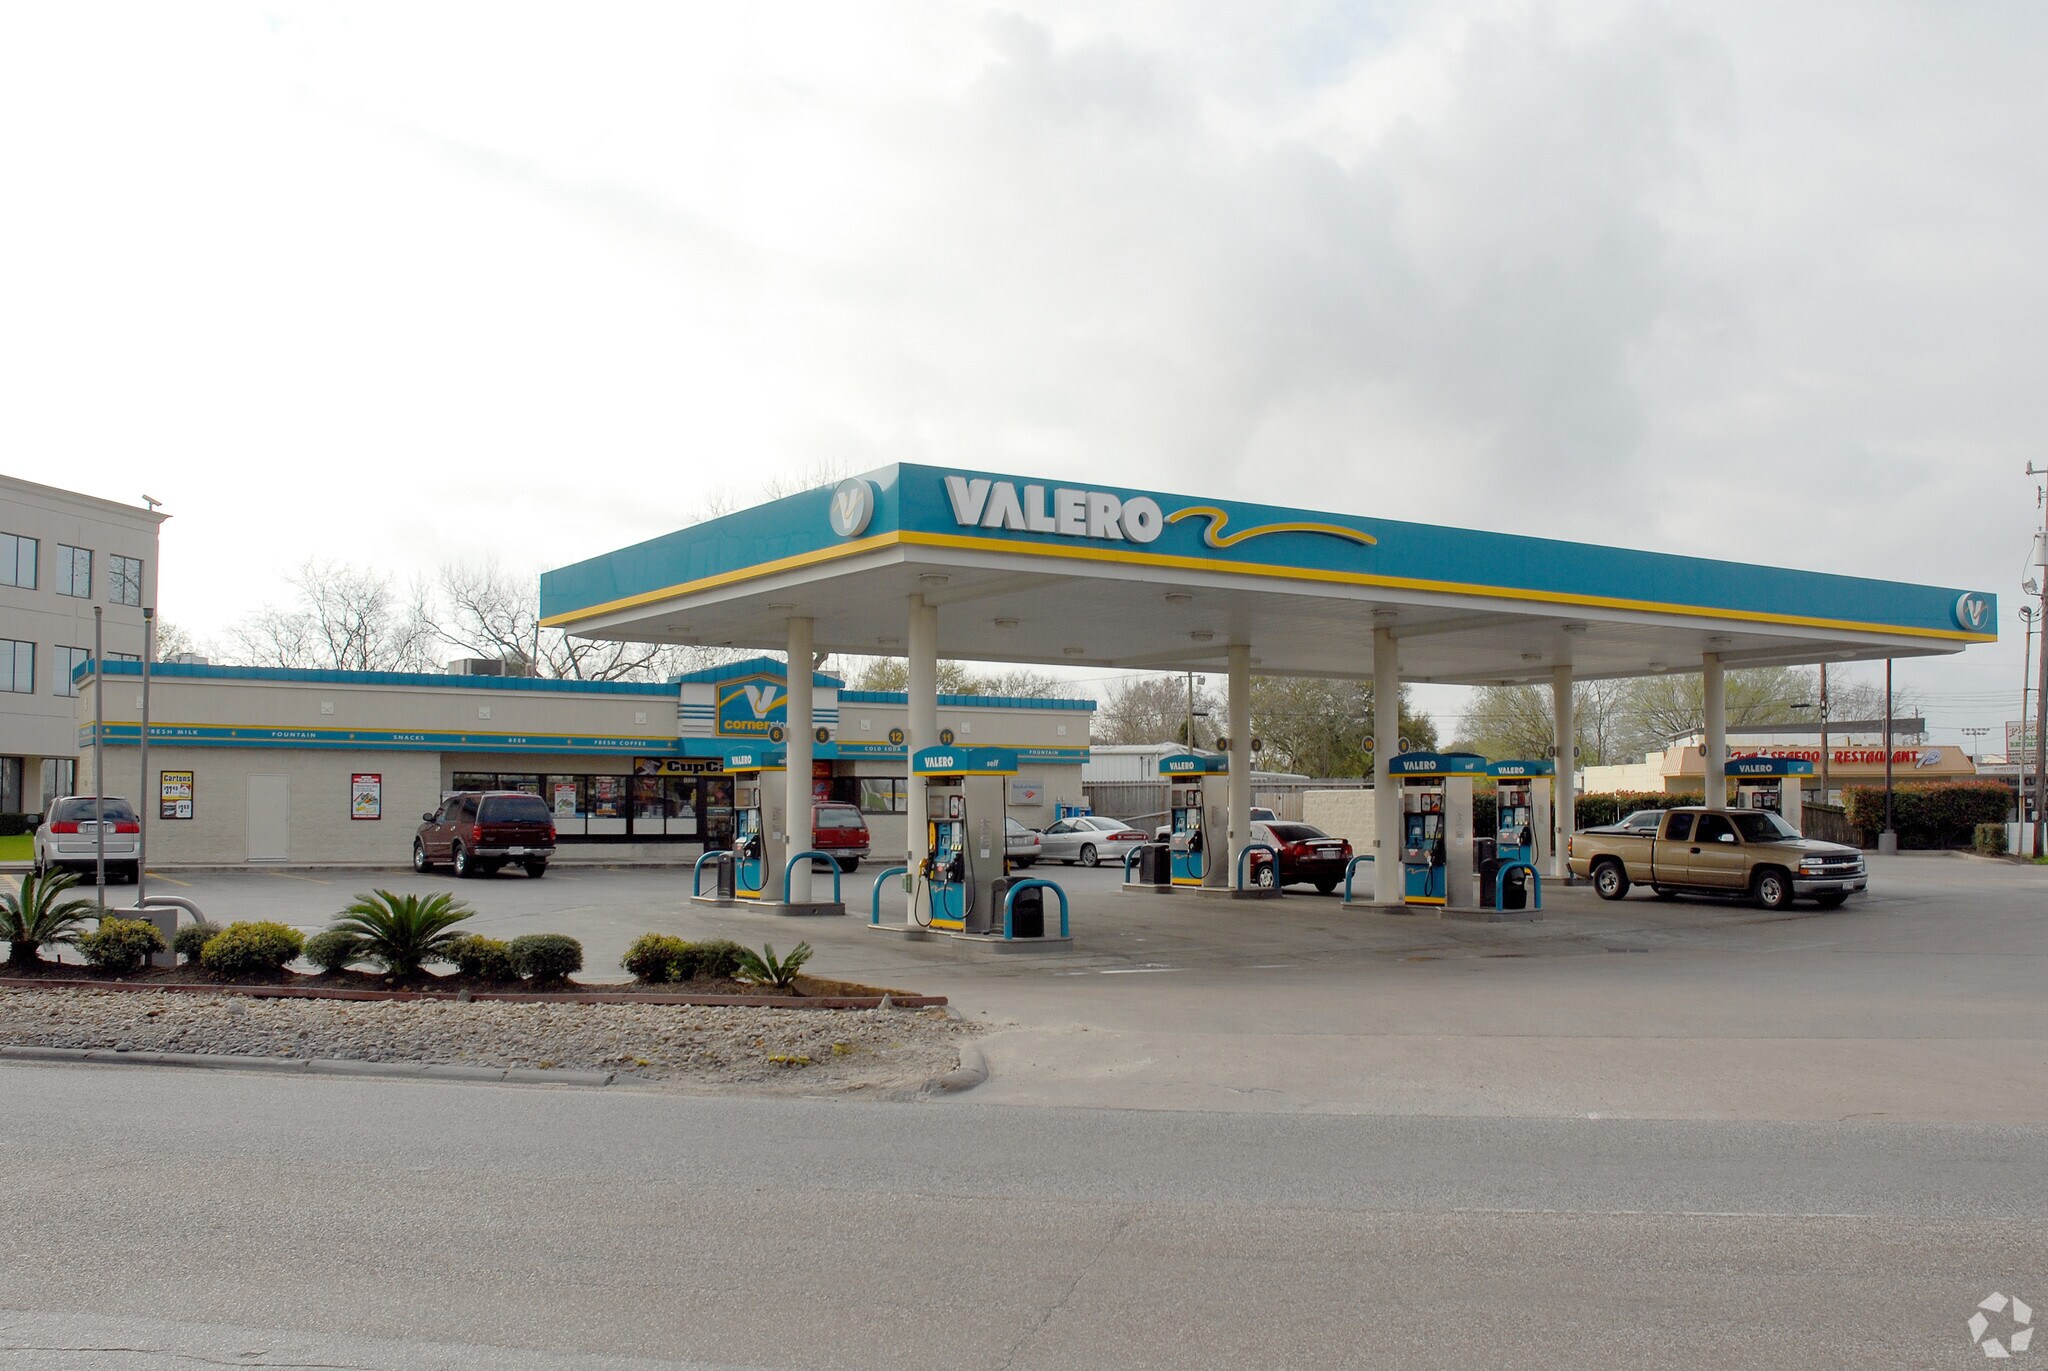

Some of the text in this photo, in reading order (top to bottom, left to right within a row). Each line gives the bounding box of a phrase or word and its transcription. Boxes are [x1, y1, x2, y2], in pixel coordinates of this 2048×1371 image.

[945, 476, 1163, 543] VALERO
[724, 719, 787, 731] cornersto
[773, 730, 780, 739] 6
[820, 731, 825, 740] 5
[891, 732, 902, 742] 12
[943, 733, 951, 742] 11
[1365, 741, 1373, 749] 10
[731, 755, 752, 765] VALERO
[924, 756, 954, 768] VALERO
[1770, 751, 1828, 763] SEAFOO
[1834, 751, 1918, 764] RESTAUANT
[986, 759, 999, 767] self
[1169, 761, 1195, 770] VALERO
[1403, 760, 1437, 771] VALERO
[1498, 766, 1525, 774] VALERO
[1739, 764, 1772, 773] VALERO
[164, 774, 191, 782] Cartons
